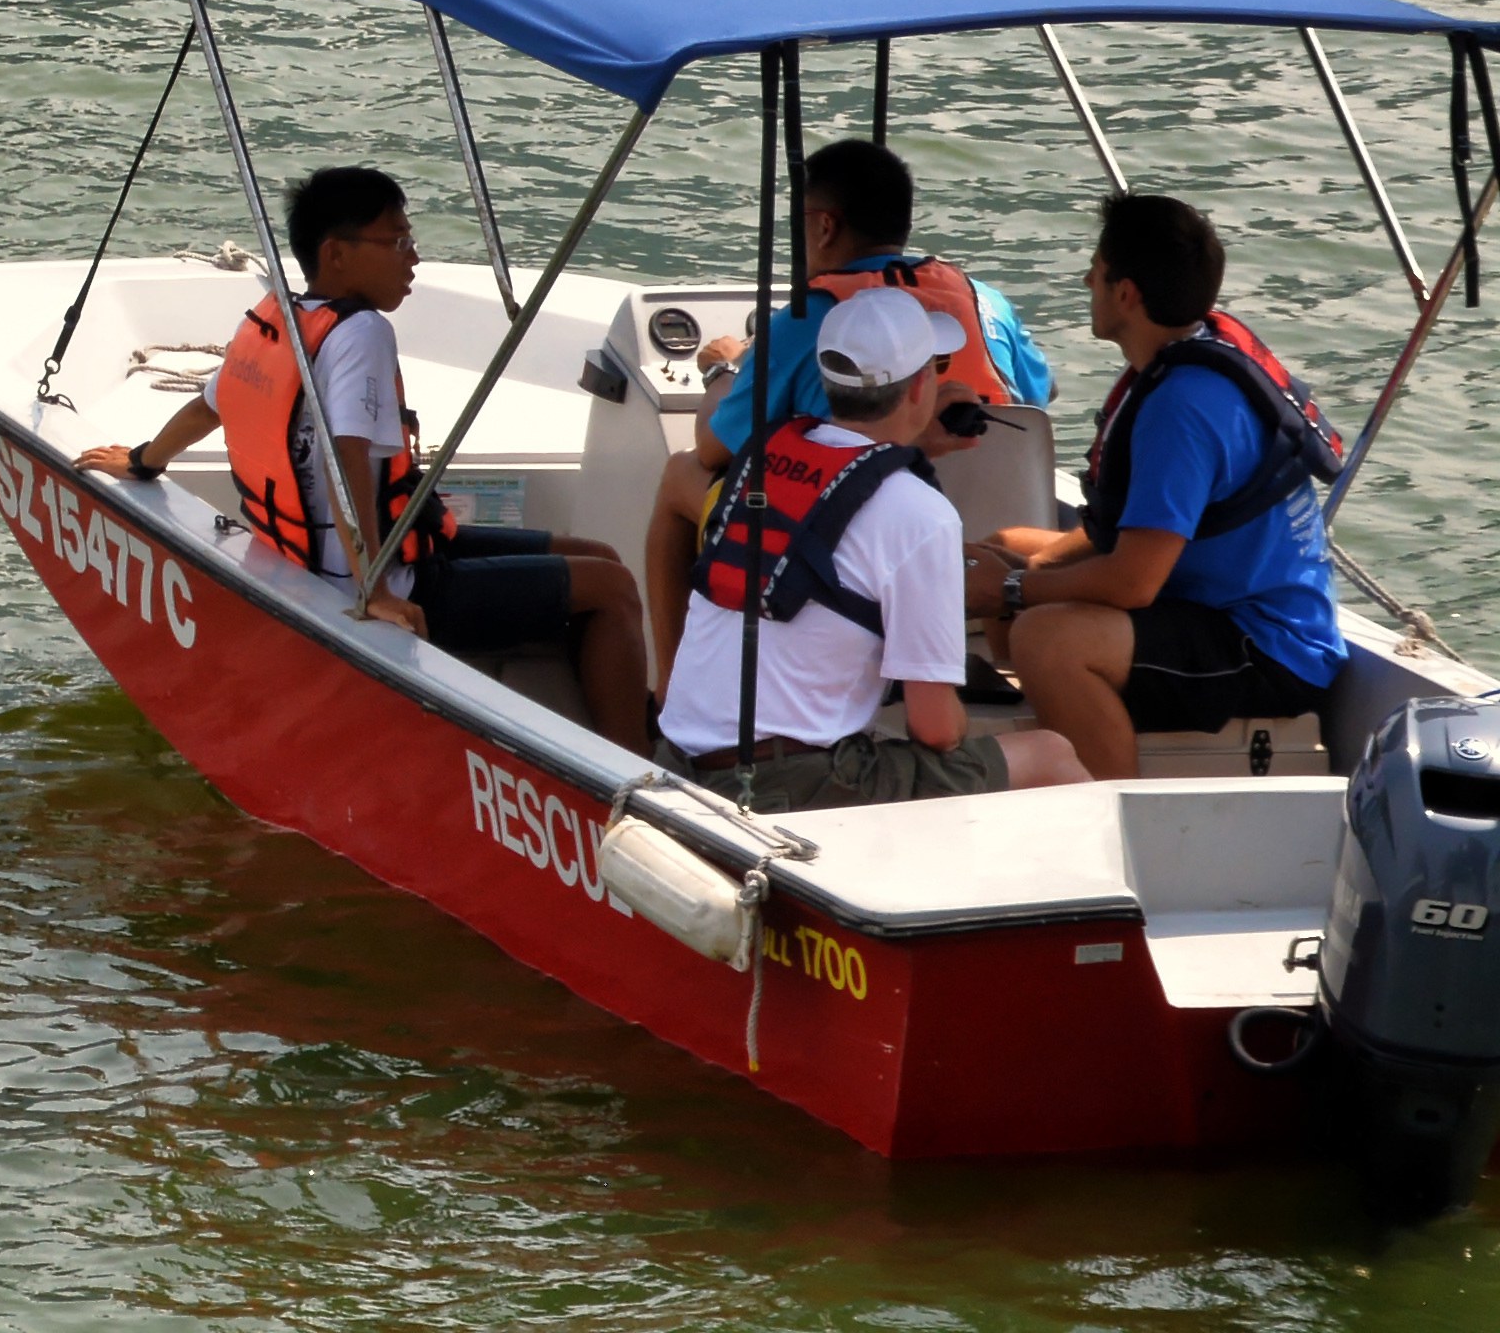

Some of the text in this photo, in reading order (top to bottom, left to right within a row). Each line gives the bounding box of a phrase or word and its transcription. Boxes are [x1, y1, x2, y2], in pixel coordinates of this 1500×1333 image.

[764, 453, 823, 491] SDBA
[40, 474, 154, 624] 15477
[162, 558, 196, 649] C
[466, 749, 634, 918] RESCU
[1411, 898, 1489, 930] 60
[794, 925, 867, 1001] 1700
